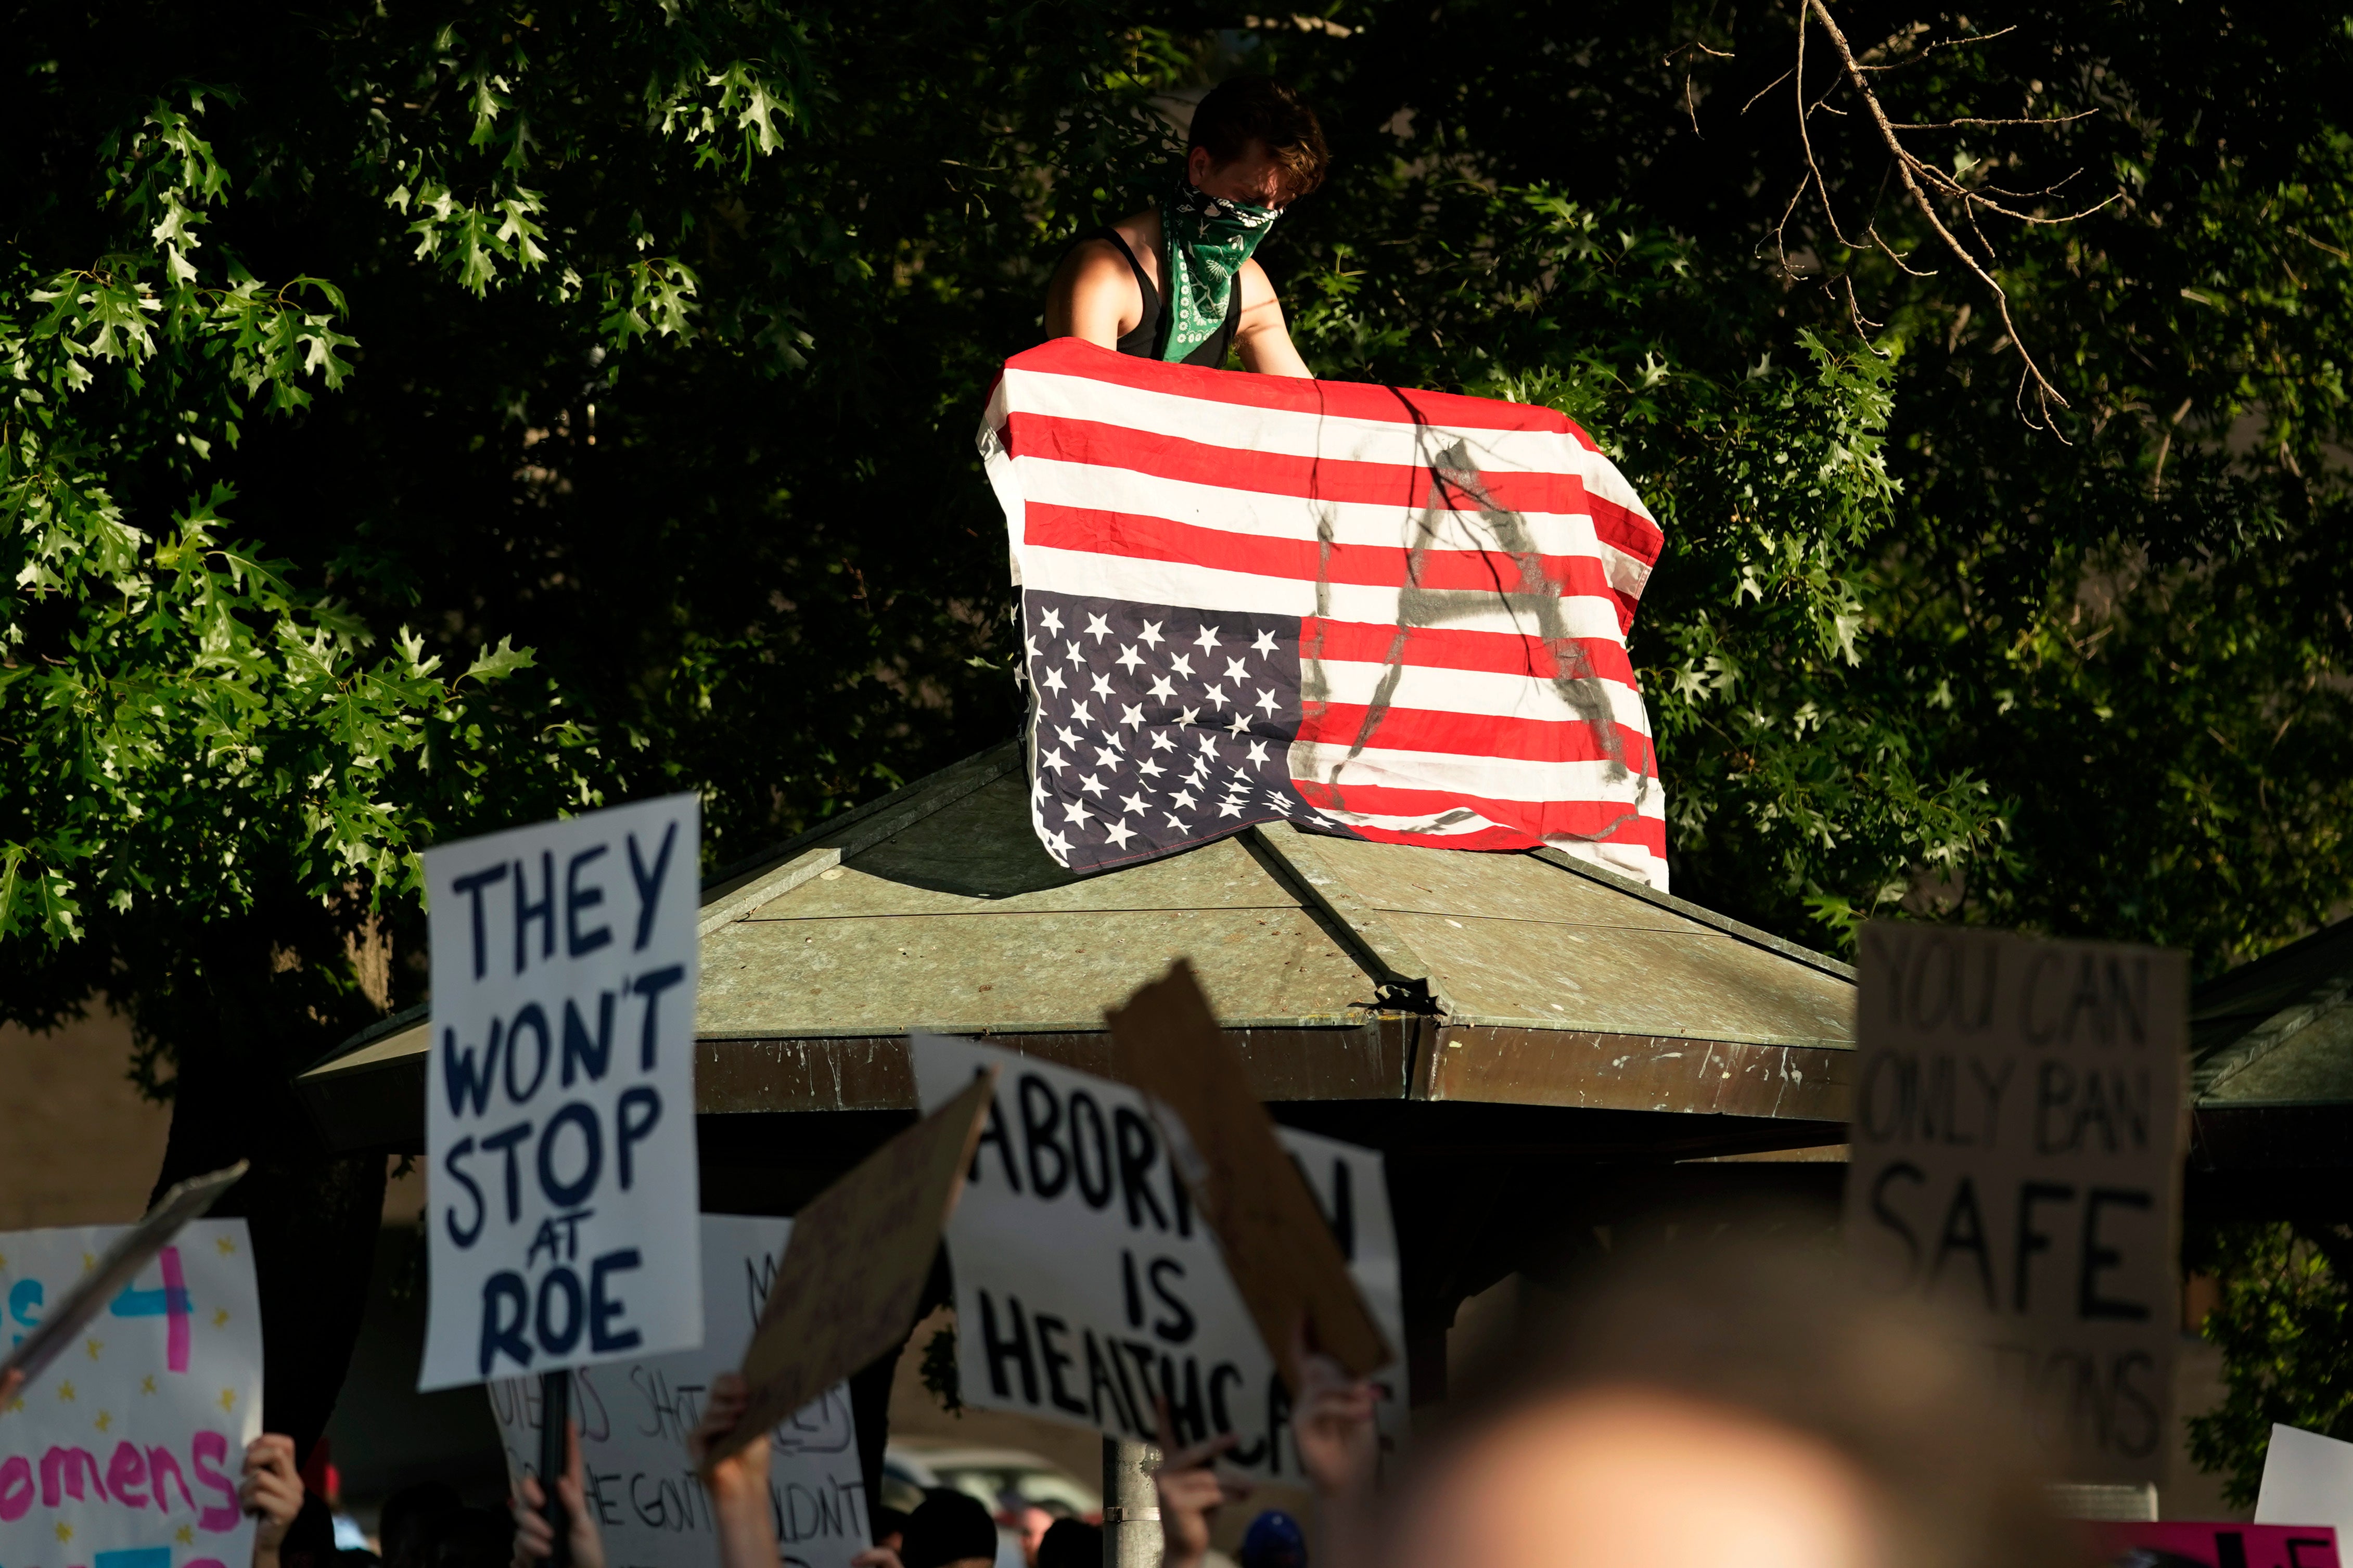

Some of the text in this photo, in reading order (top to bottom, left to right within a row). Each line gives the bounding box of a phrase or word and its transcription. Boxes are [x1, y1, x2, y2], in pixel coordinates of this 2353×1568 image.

[451, 820, 678, 981] THEY
[441, 963, 686, 1118] WON'T
[1867, 931, 2150, 1046] YOU CAN
[1856, 1044, 2150, 1155] ONLY BAN
[445, 1085, 662, 1249] STOP
[527, 1207, 595, 1268] AT
[1121, 1249, 1196, 1344] IS
[1868, 1158, 2154, 1323] SAFE
[479, 1248, 643, 1376] ROE
